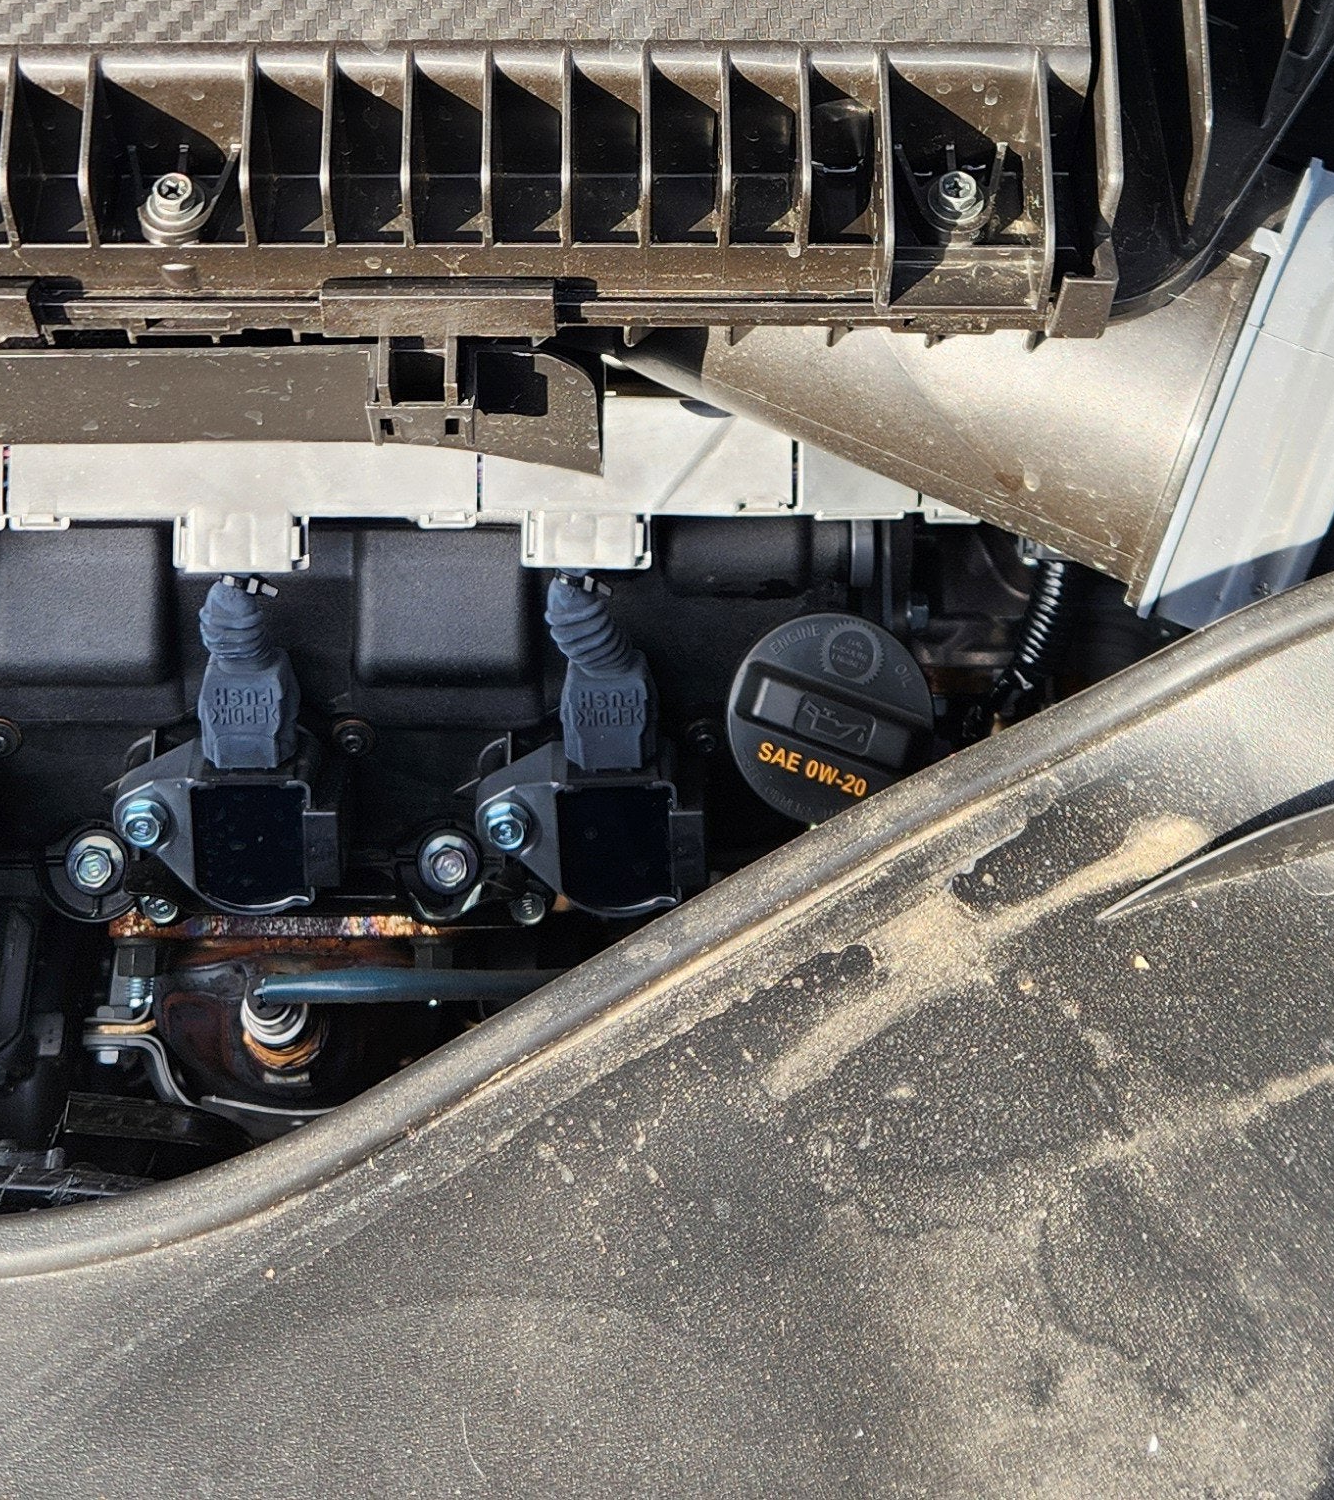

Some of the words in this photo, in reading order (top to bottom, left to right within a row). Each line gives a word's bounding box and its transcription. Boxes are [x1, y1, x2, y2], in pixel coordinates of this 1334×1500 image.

[769, 623, 821, 655] ENGINE
[894, 663, 914, 688] OIL
[215, 687, 274, 706] PUSH
[578, 689, 640, 708] PUSH
[757, 742, 803, 773] SAE
[804, 760, 868, 797] 0W-20
